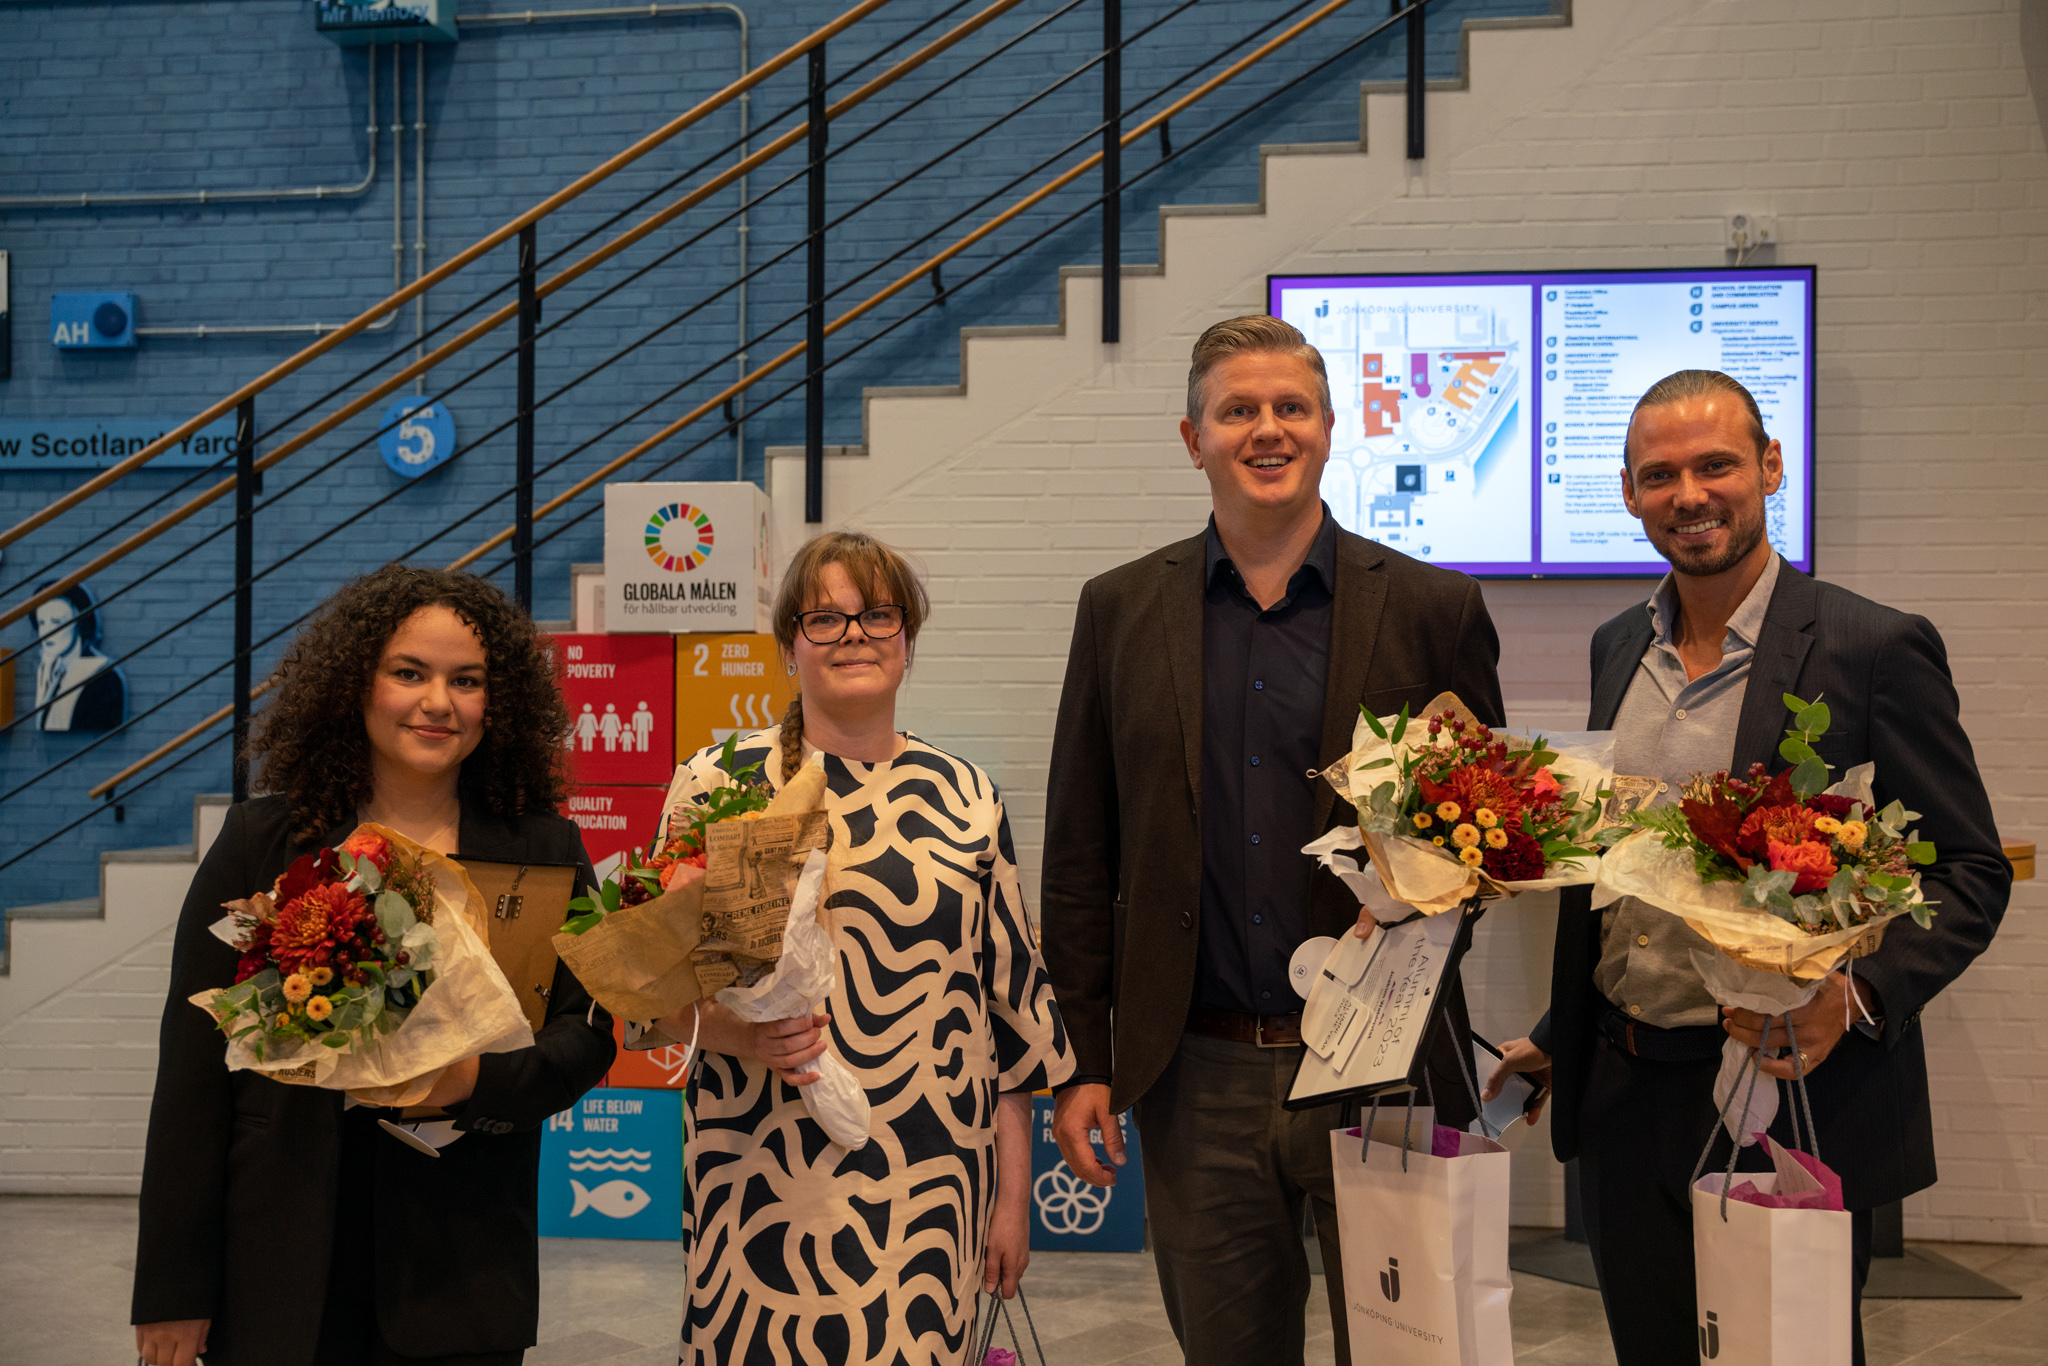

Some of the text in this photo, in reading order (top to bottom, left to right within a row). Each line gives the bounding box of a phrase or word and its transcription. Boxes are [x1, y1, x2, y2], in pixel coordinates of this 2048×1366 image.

[322, 5, 429, 23] Mr Memory
[1408, 304, 1479, 314] UNIVERSITY
[53, 321, 90, 344] AH
[32, 432, 164, 457] Scotlan
[397, 407, 435, 465] 5
[624, 583, 685, 600] GLOBALA
[691, 579, 736, 600] MÅLEN
[624, 602, 737, 616] för hållbar utveckling
[567, 645, 583, 660] NO
[722, 644, 749, 658] ZERO
[694, 644, 709, 676] 2
[567, 664, 616, 678] POVERTY
[722, 662, 764, 676] HUNGER
[569, 797, 613, 812] QUALITY
[1373, 937, 1425, 1067] the Year 2023
[1391, 955, 1429, 1044] Alumni of
[583, 1099, 643, 1115] LIFE BELOW
[583, 1118, 619, 1132] WATER
[1353, 1302, 1443, 1344] JÖNKÖPING UNIVERSITY
